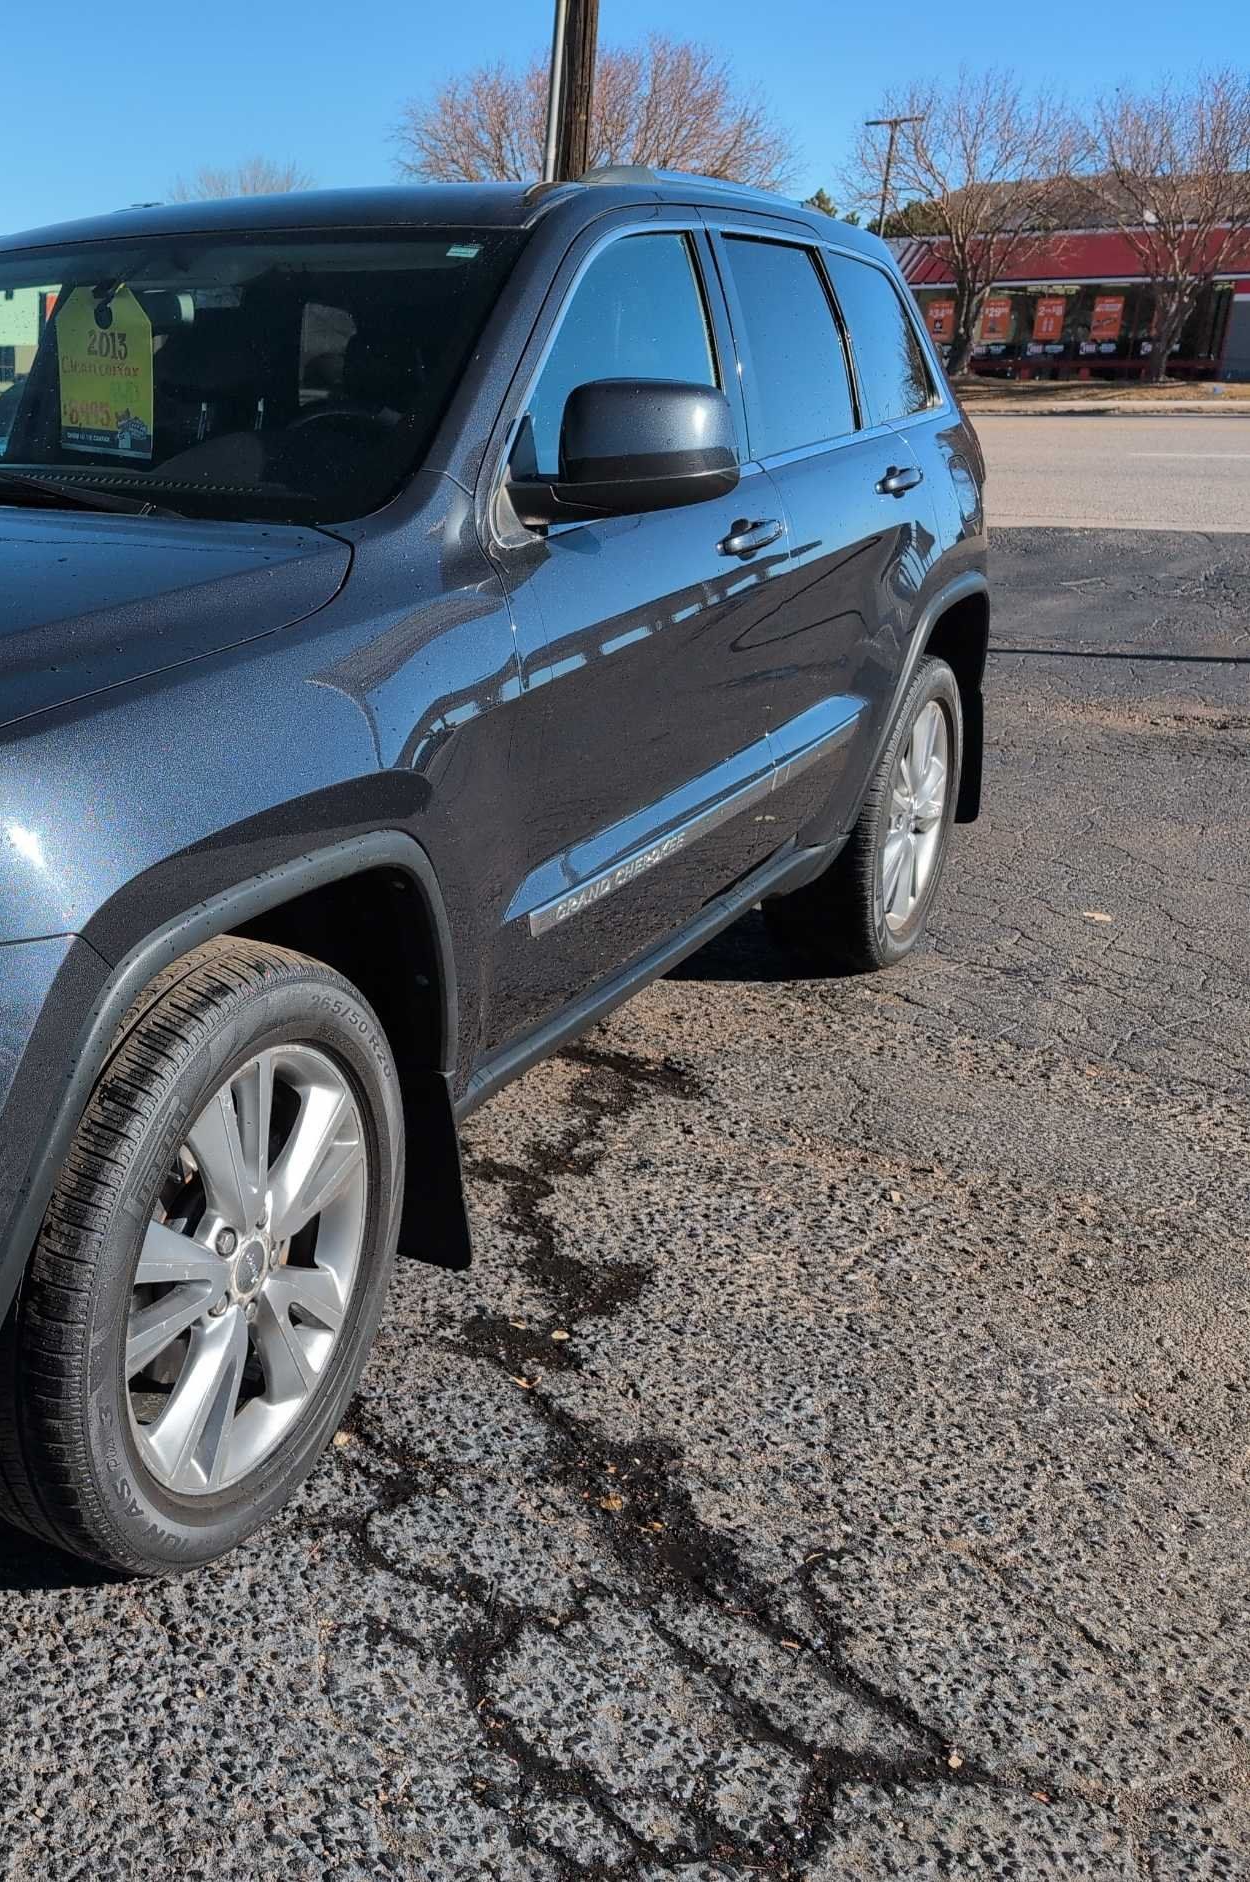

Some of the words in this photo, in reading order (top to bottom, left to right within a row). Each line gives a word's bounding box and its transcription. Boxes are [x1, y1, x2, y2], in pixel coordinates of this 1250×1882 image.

[87, 329, 128, 360] 2013
[555, 878, 612, 921] GRAND
[615, 832, 686, 885] CHEROKEE
[310, 993, 369, 1034] 265/50
[112, 1477, 144, 1518] AS
